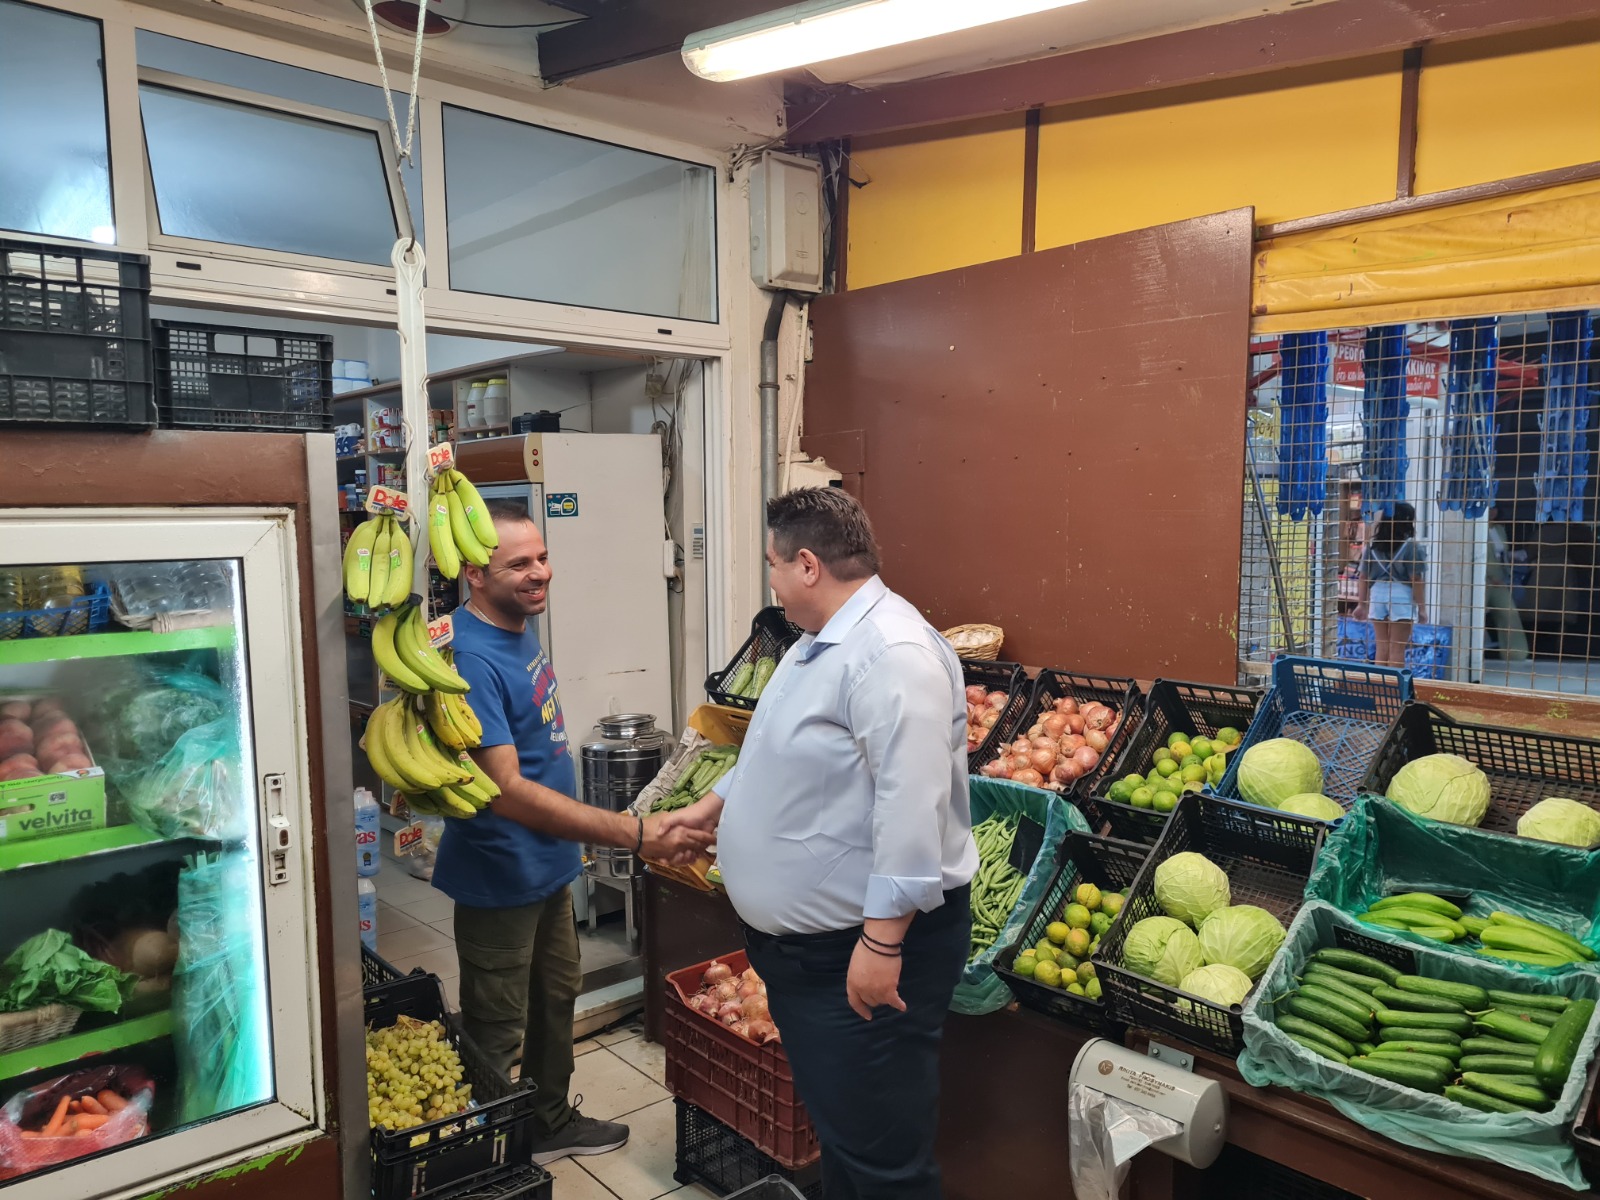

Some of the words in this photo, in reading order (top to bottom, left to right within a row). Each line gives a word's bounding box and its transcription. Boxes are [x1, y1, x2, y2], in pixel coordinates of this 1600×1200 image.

[430, 448, 450, 466] Dole
[373, 489, 408, 510] Dole
[429, 622, 450, 639] Dole
[19, 808, 92, 831] velvita
[400, 827, 422, 846] Dole
